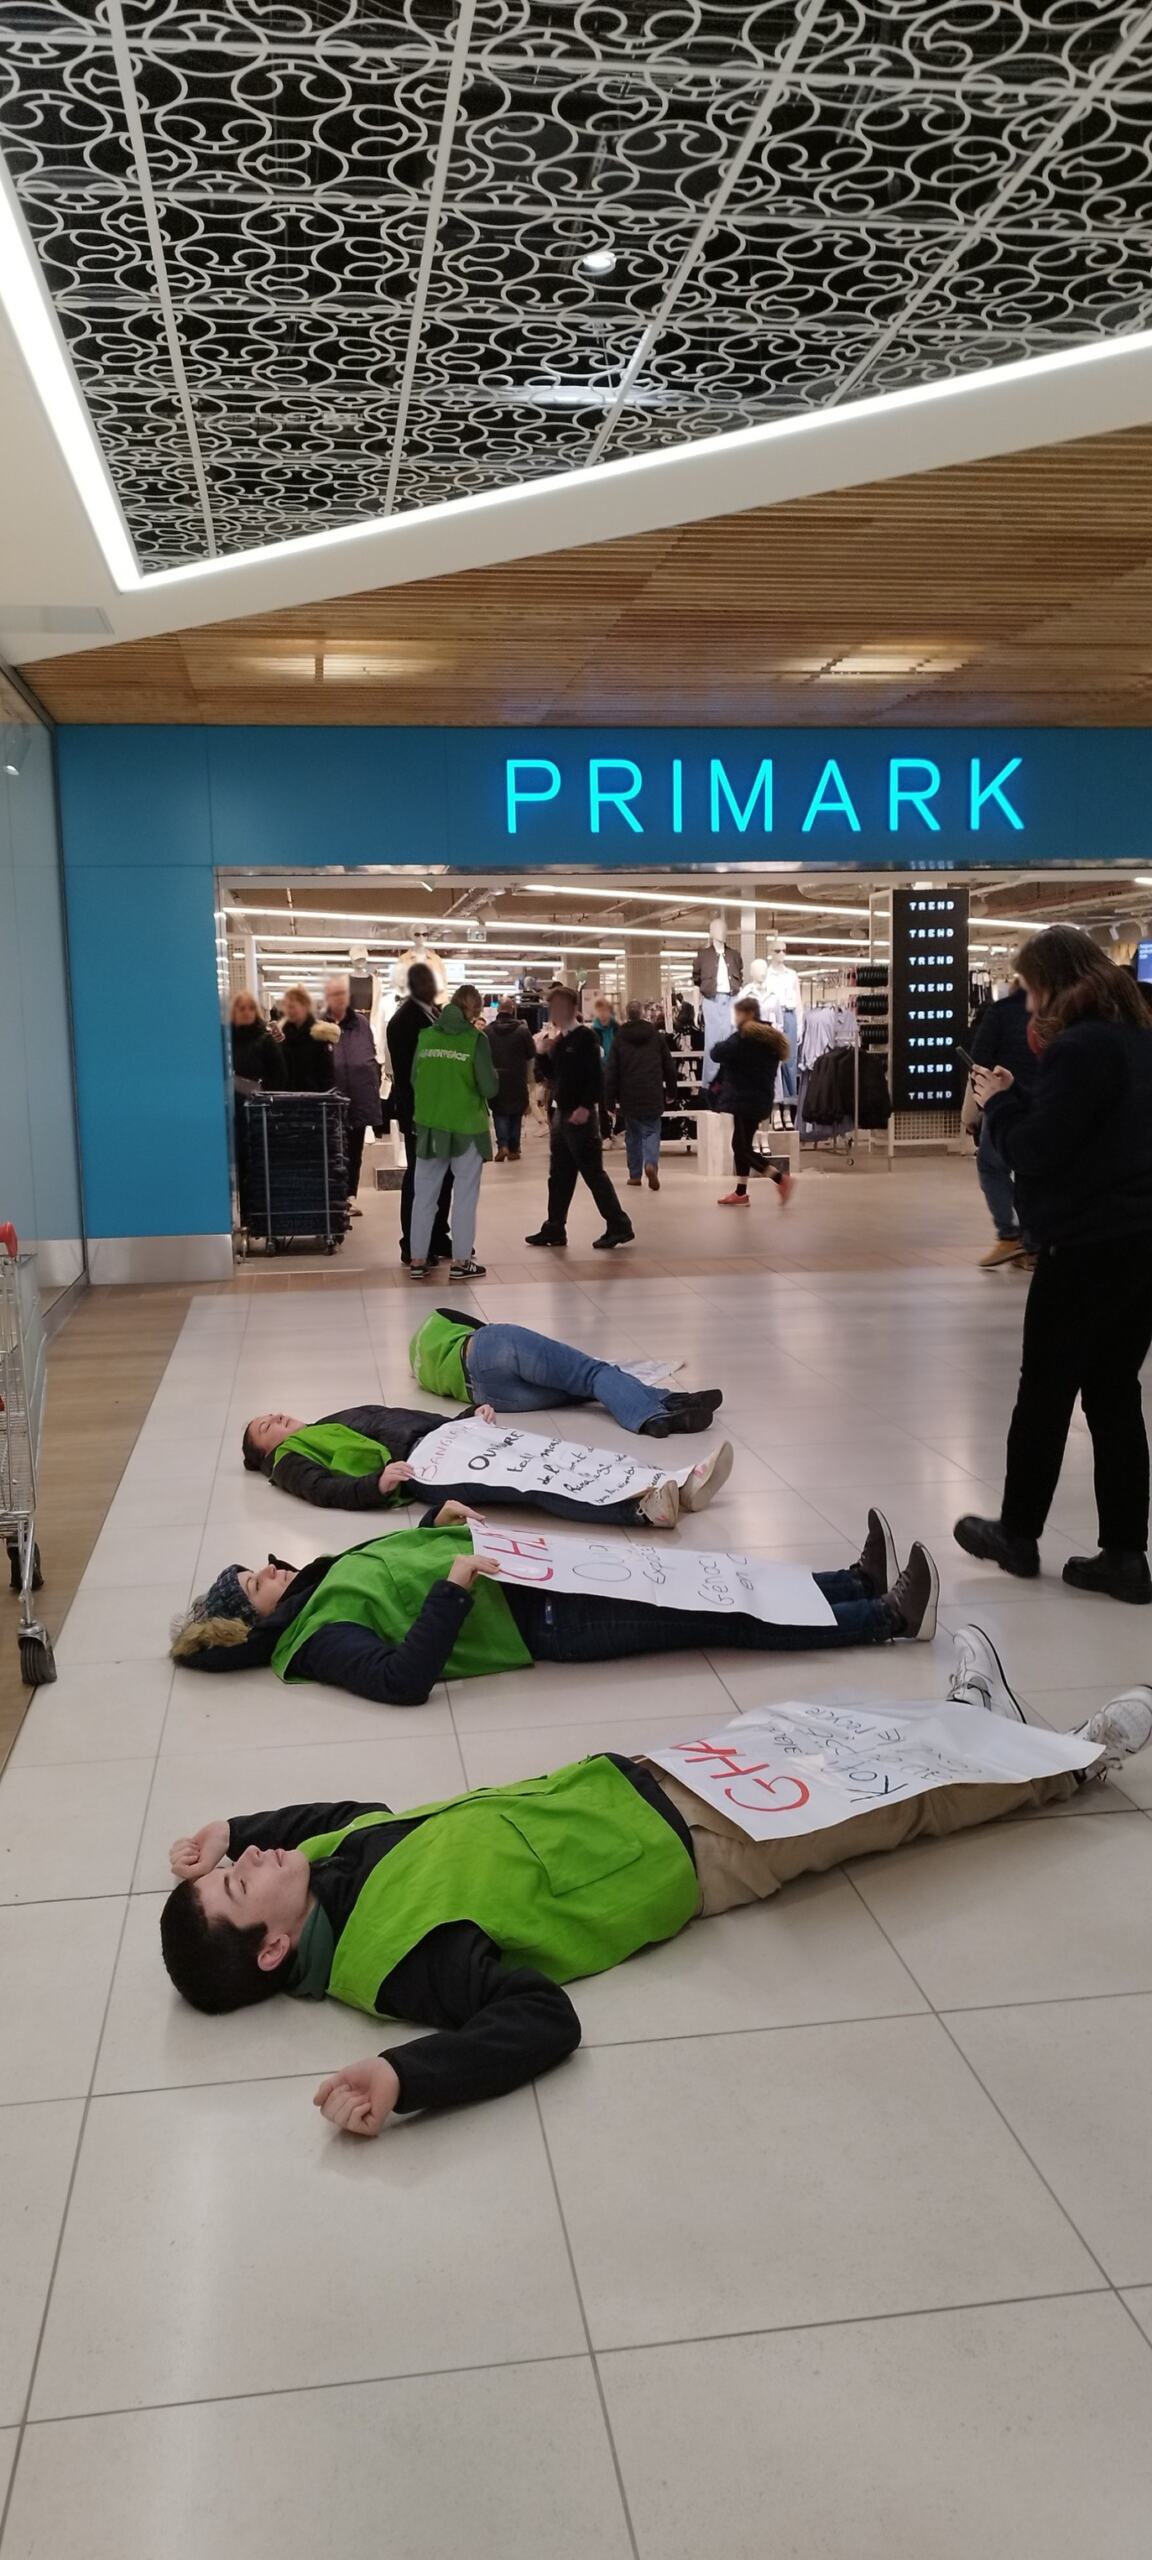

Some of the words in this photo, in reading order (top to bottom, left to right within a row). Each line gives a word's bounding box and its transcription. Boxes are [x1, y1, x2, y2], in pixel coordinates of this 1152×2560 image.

[506, 758, 1024, 834] PRIMARK
[909, 901, 954, 911] TREND
[909, 928, 954, 938] TREND
[909, 956, 953, 965] TREND
[909, 983, 953, 992] TREND
[909, 1010, 953, 1019] TREND
[909, 1037, 953, 1046] TREND
[909, 1064, 952, 1073] TREND
[909, 1091, 951, 1099] TREND
